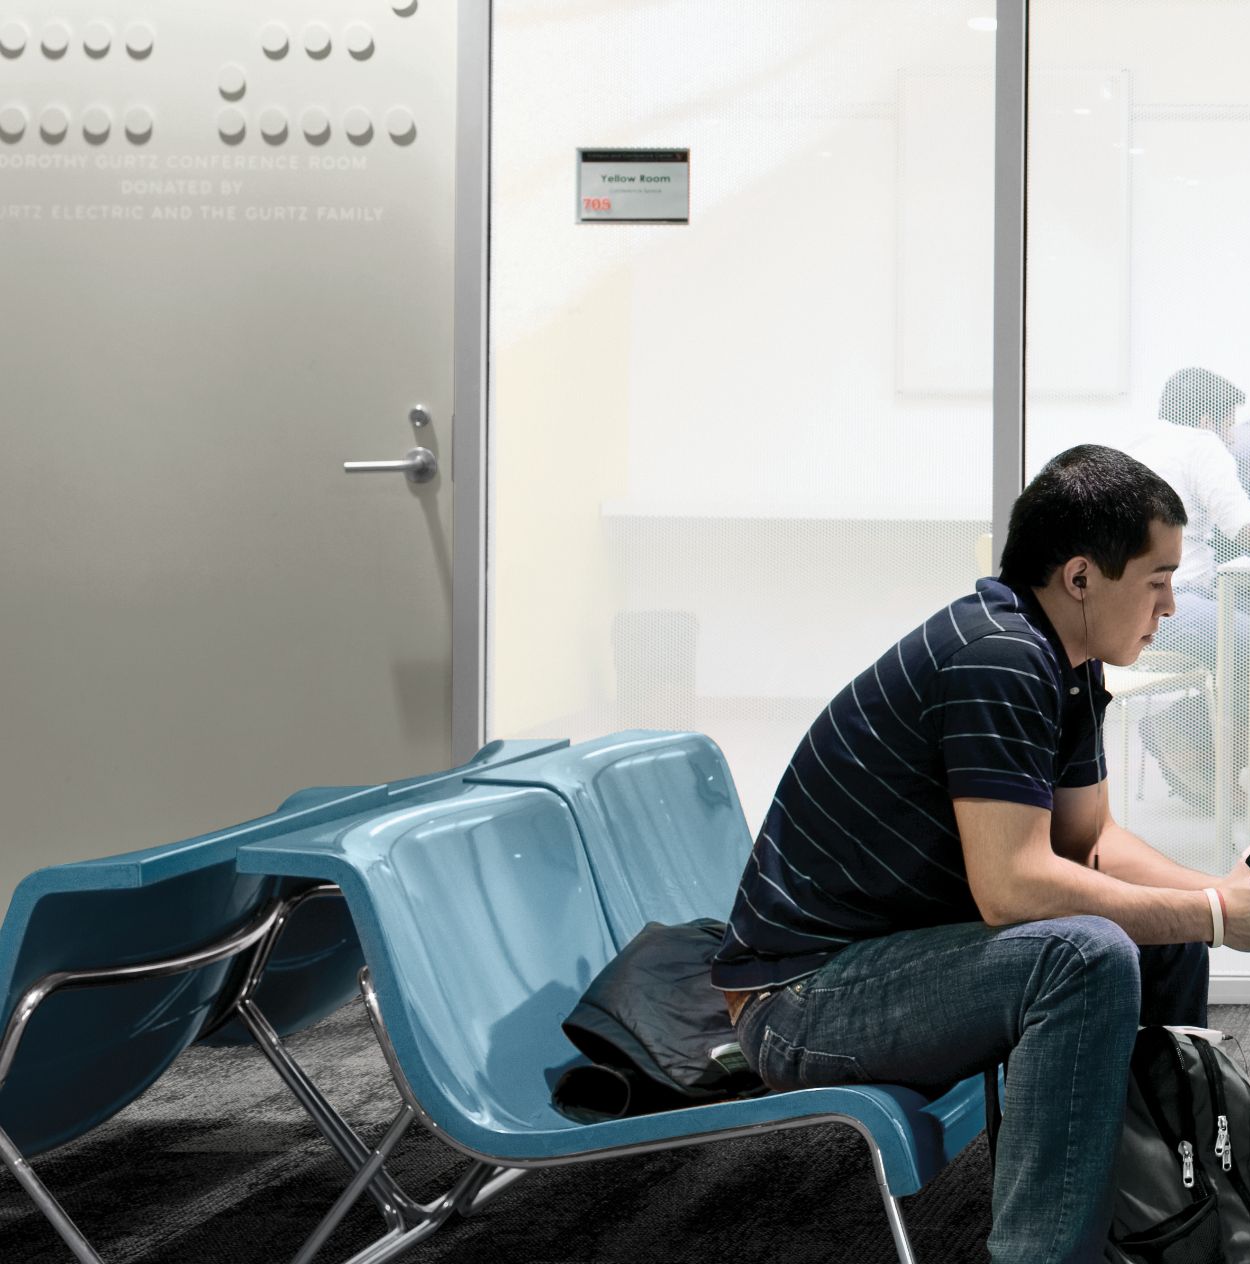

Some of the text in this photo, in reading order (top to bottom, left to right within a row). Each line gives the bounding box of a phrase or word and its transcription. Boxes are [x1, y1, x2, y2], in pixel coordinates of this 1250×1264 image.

[0, 154, 368, 170] DOROTHY GURTZ CONFERENCE ROOM
[120, 179, 244, 195] DONATED BY
[601, 174, 671, 184] Yellow Room
[51, 204, 144, 220] ELECTRIC
[151, 204, 193, 220] AND
[199, 205, 237, 221] THE
[245, 205, 309, 221] GURTZ
[316, 205, 385, 221] FAMILY
